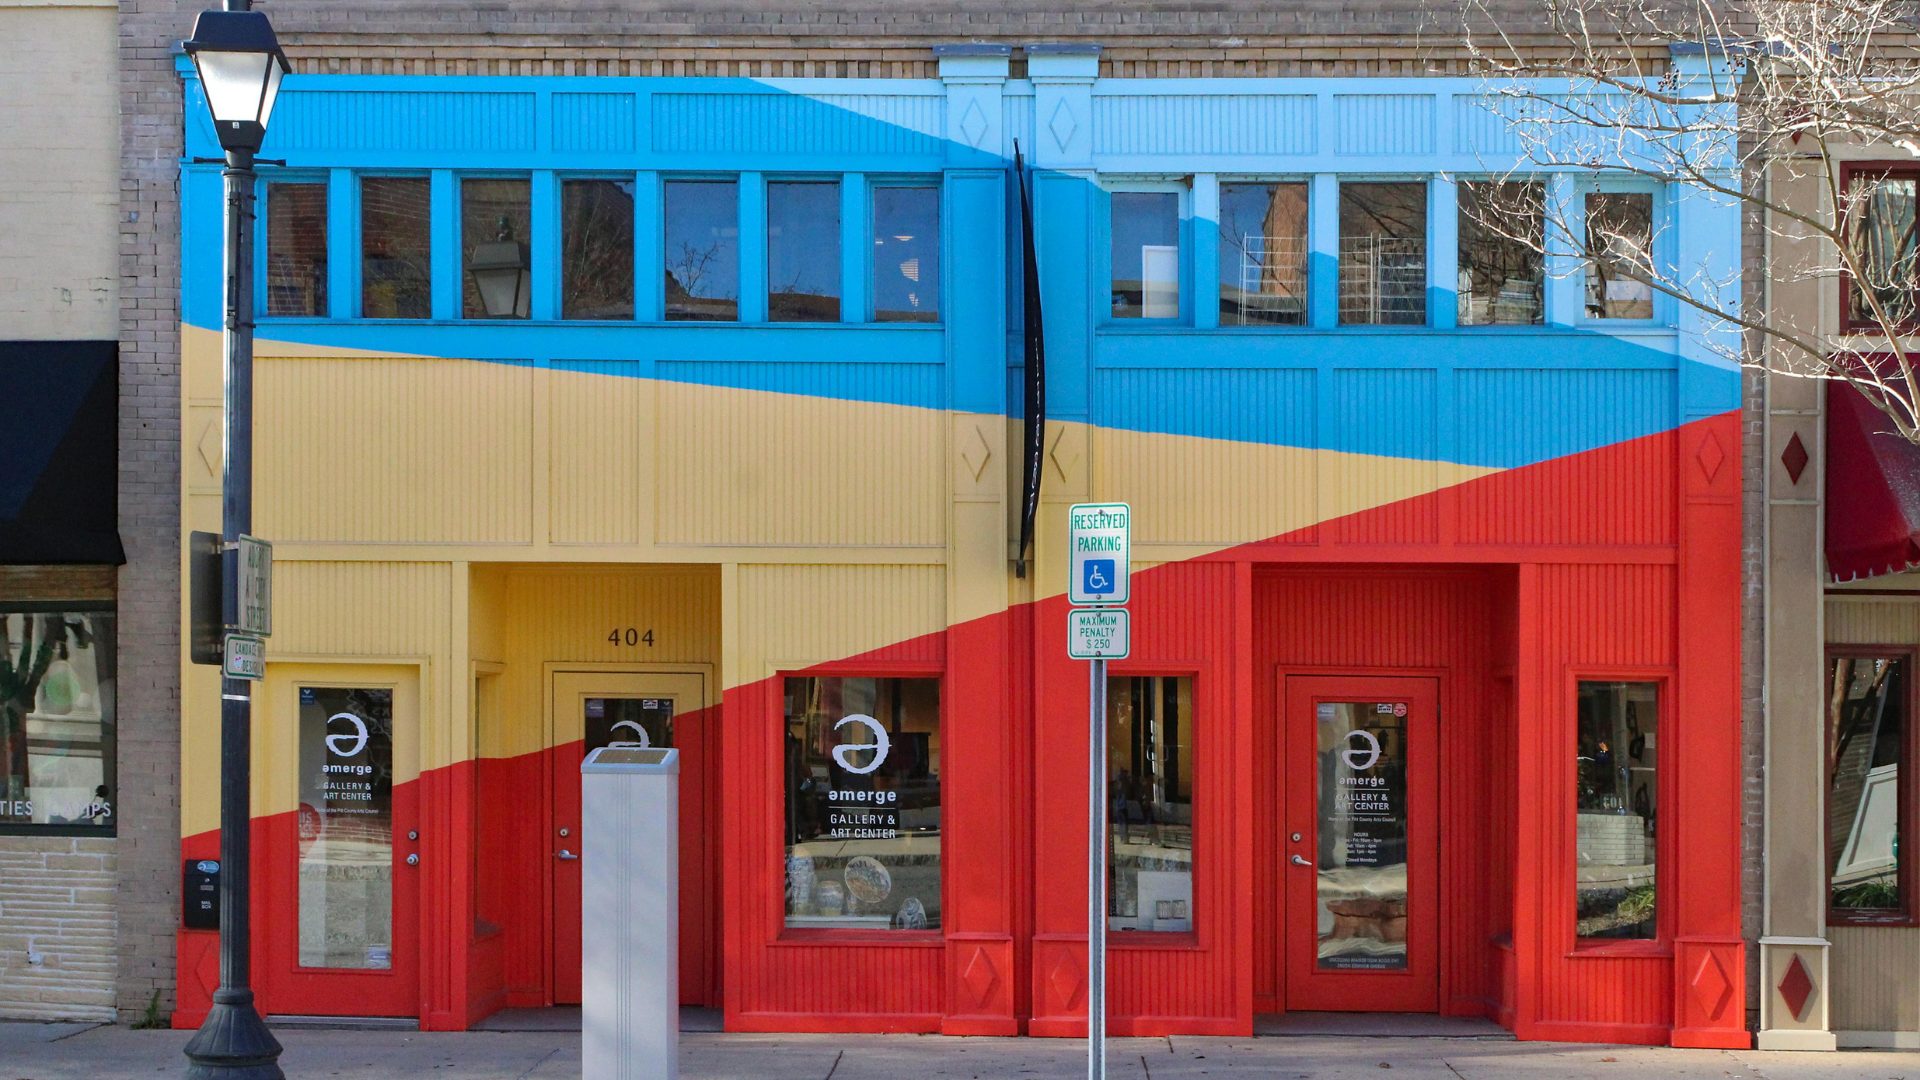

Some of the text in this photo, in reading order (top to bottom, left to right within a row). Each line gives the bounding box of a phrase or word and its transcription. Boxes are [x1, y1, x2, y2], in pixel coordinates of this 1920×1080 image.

[1074, 514, 1125, 529] RESERVED
[1078, 536, 1121, 552] PARKING
[245, 574, 250, 598] A
[1080, 616, 1117, 626] MAXIMUM
[1080, 627, 1115, 637] PENALTY
[608, 628, 654, 647] 404
[1094, 639, 1110, 649] 250
[323, 782, 363, 790] GALLERY
[323, 792, 371, 800] ART CENTER
[1336, 793, 1378, 801] GALLERY
[830, 814, 895, 824] GALLERY &
[831, 828, 895, 838] ART CENTER
